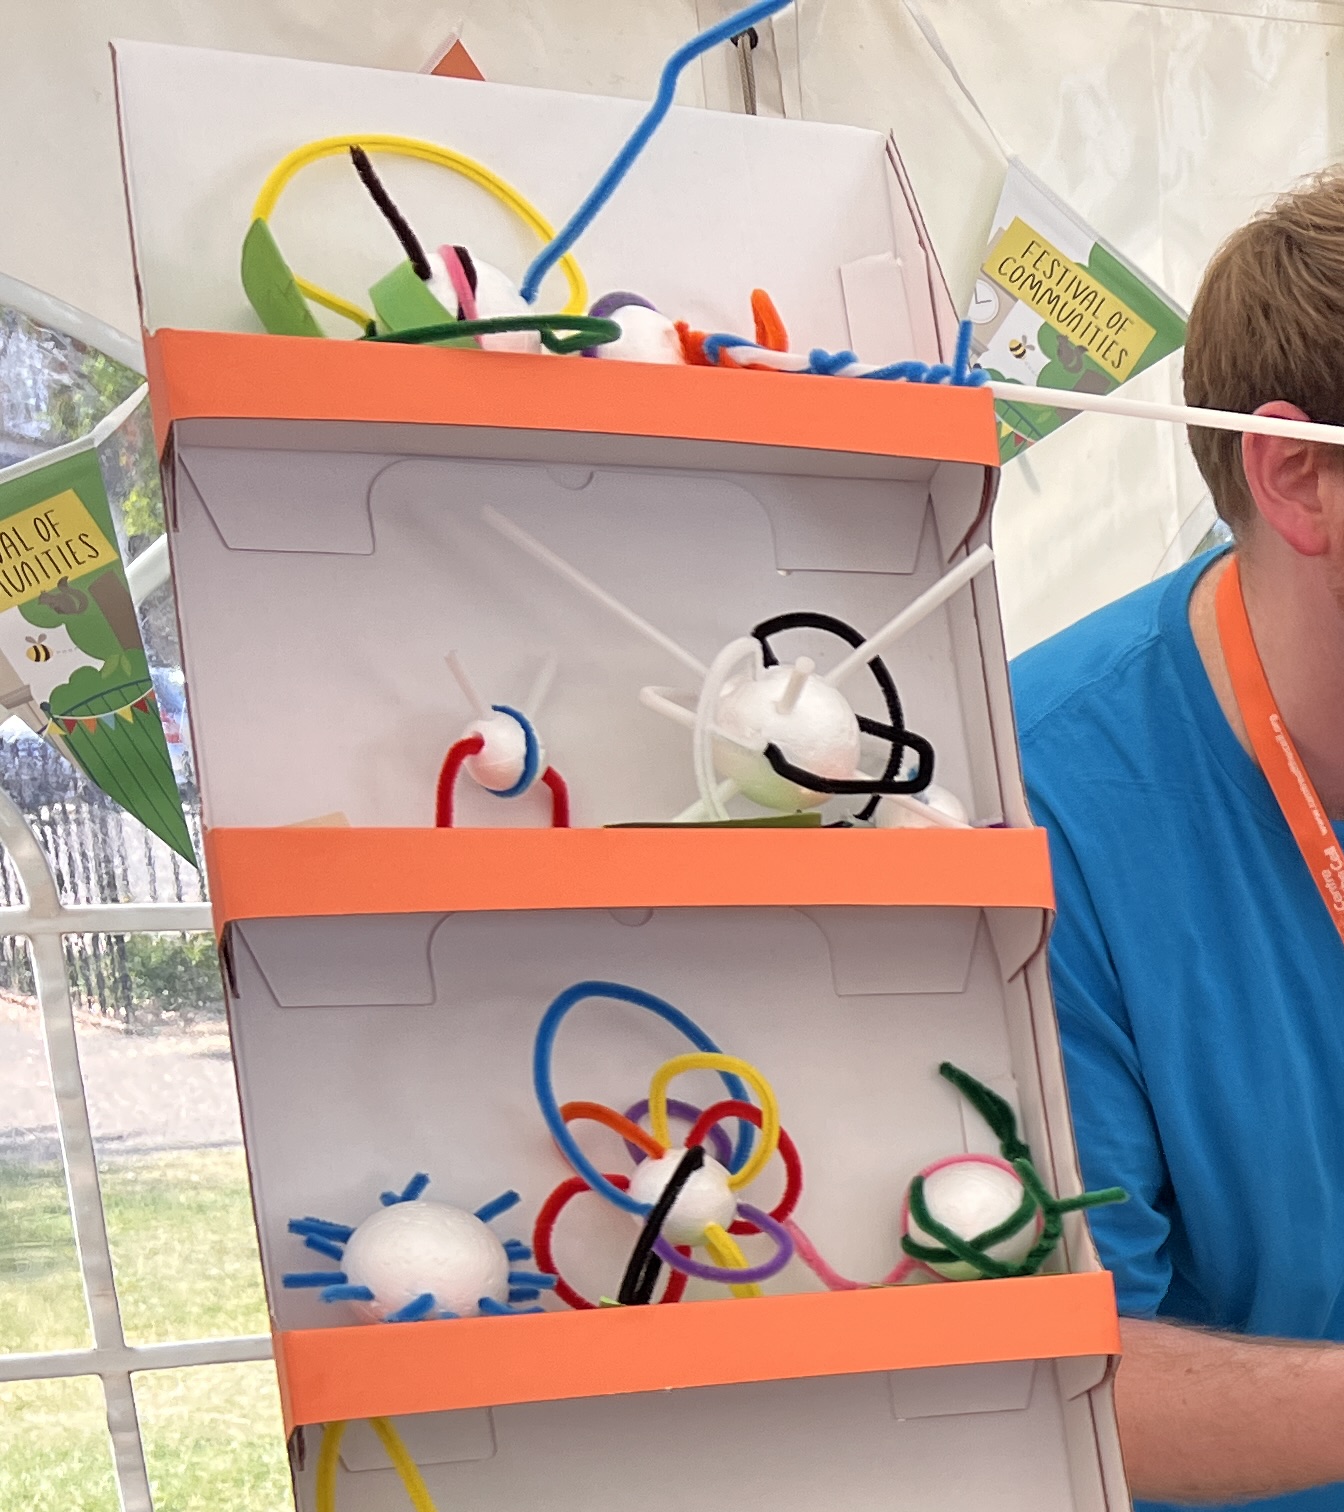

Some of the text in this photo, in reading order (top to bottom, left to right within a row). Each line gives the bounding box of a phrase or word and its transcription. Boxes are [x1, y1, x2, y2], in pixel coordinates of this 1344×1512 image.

[997, 256, 1129, 371] COMMUNITIES
[1021, 239, 1136, 336] FESTIVAL OF
[33, 509, 60, 542] OF
